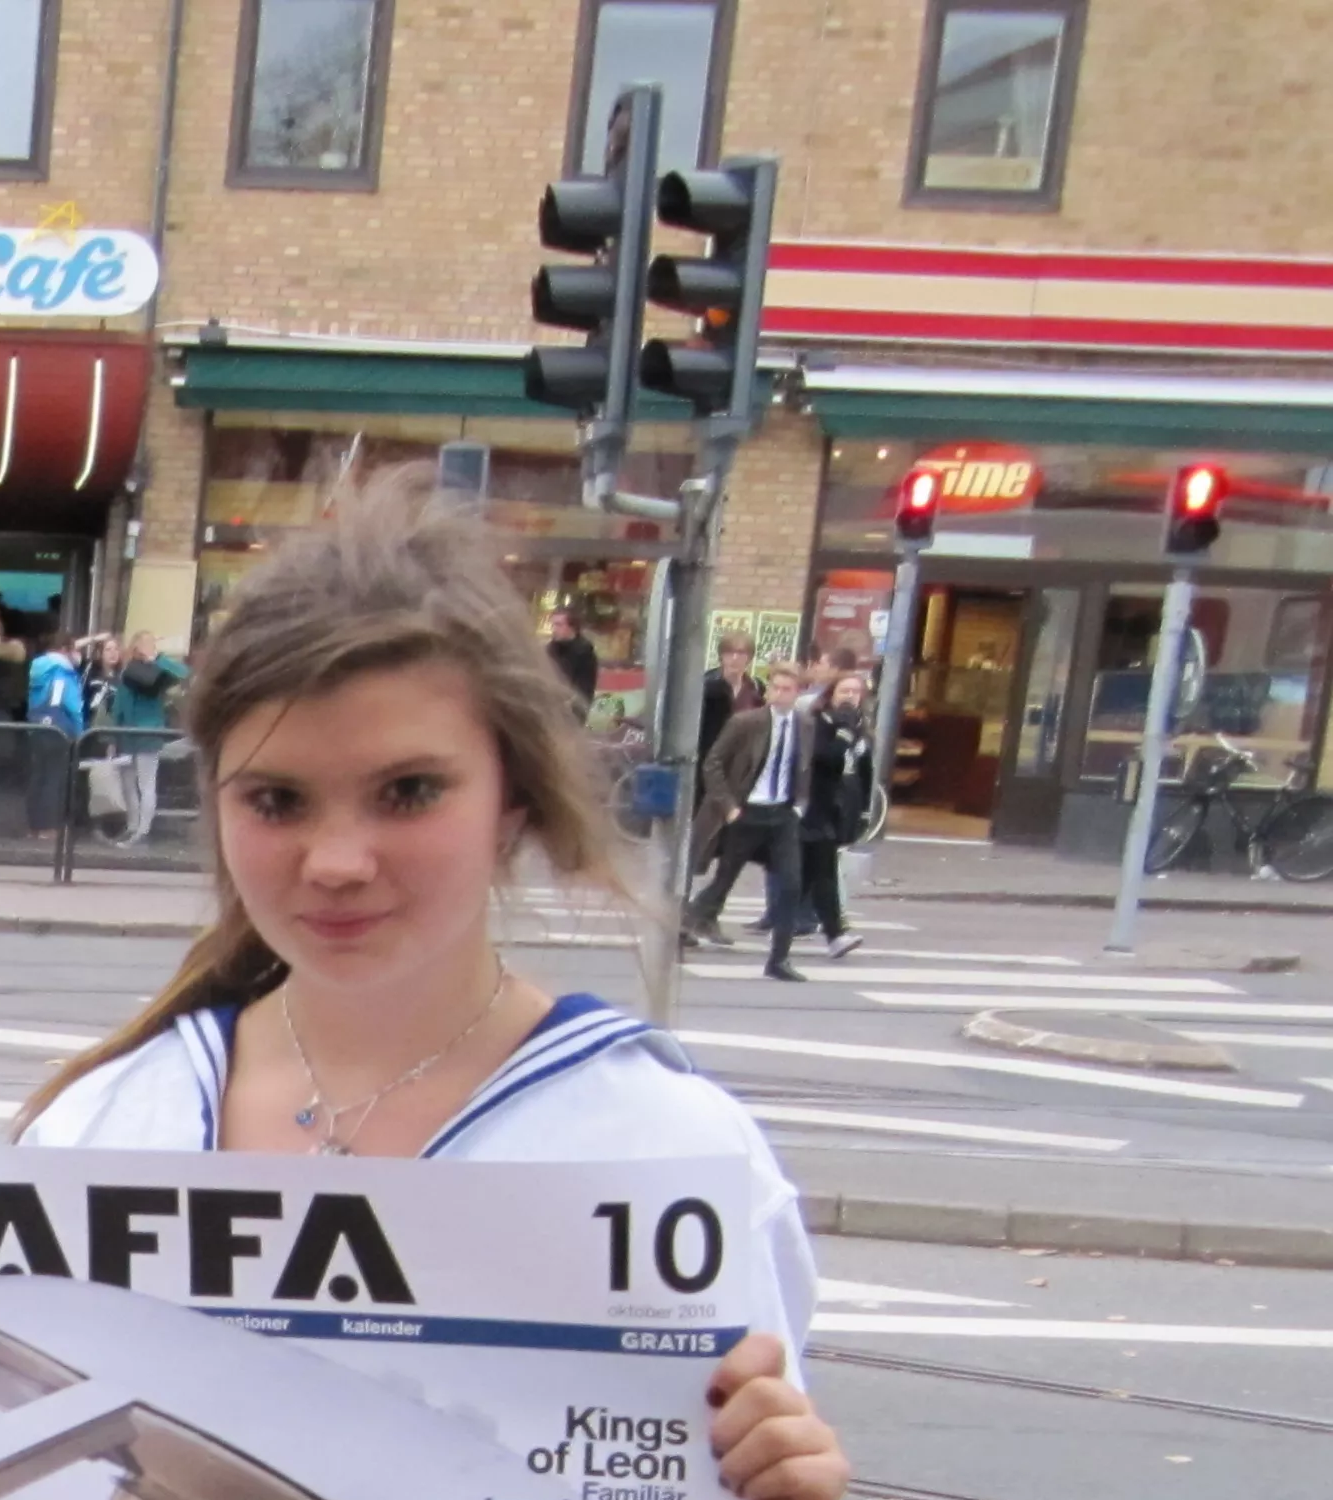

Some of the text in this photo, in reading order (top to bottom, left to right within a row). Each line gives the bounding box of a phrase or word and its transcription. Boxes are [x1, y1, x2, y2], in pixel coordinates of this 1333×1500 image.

[591, 1196, 724, 1295] 10
[341, 1315, 423, 1338] kalender
[607, 1303, 717, 1320] oktober 2010
[620, 1331, 716, 1353] GRATIS
[565, 1405, 689, 1451] Kings
[527, 1441, 687, 1482] of Leon
